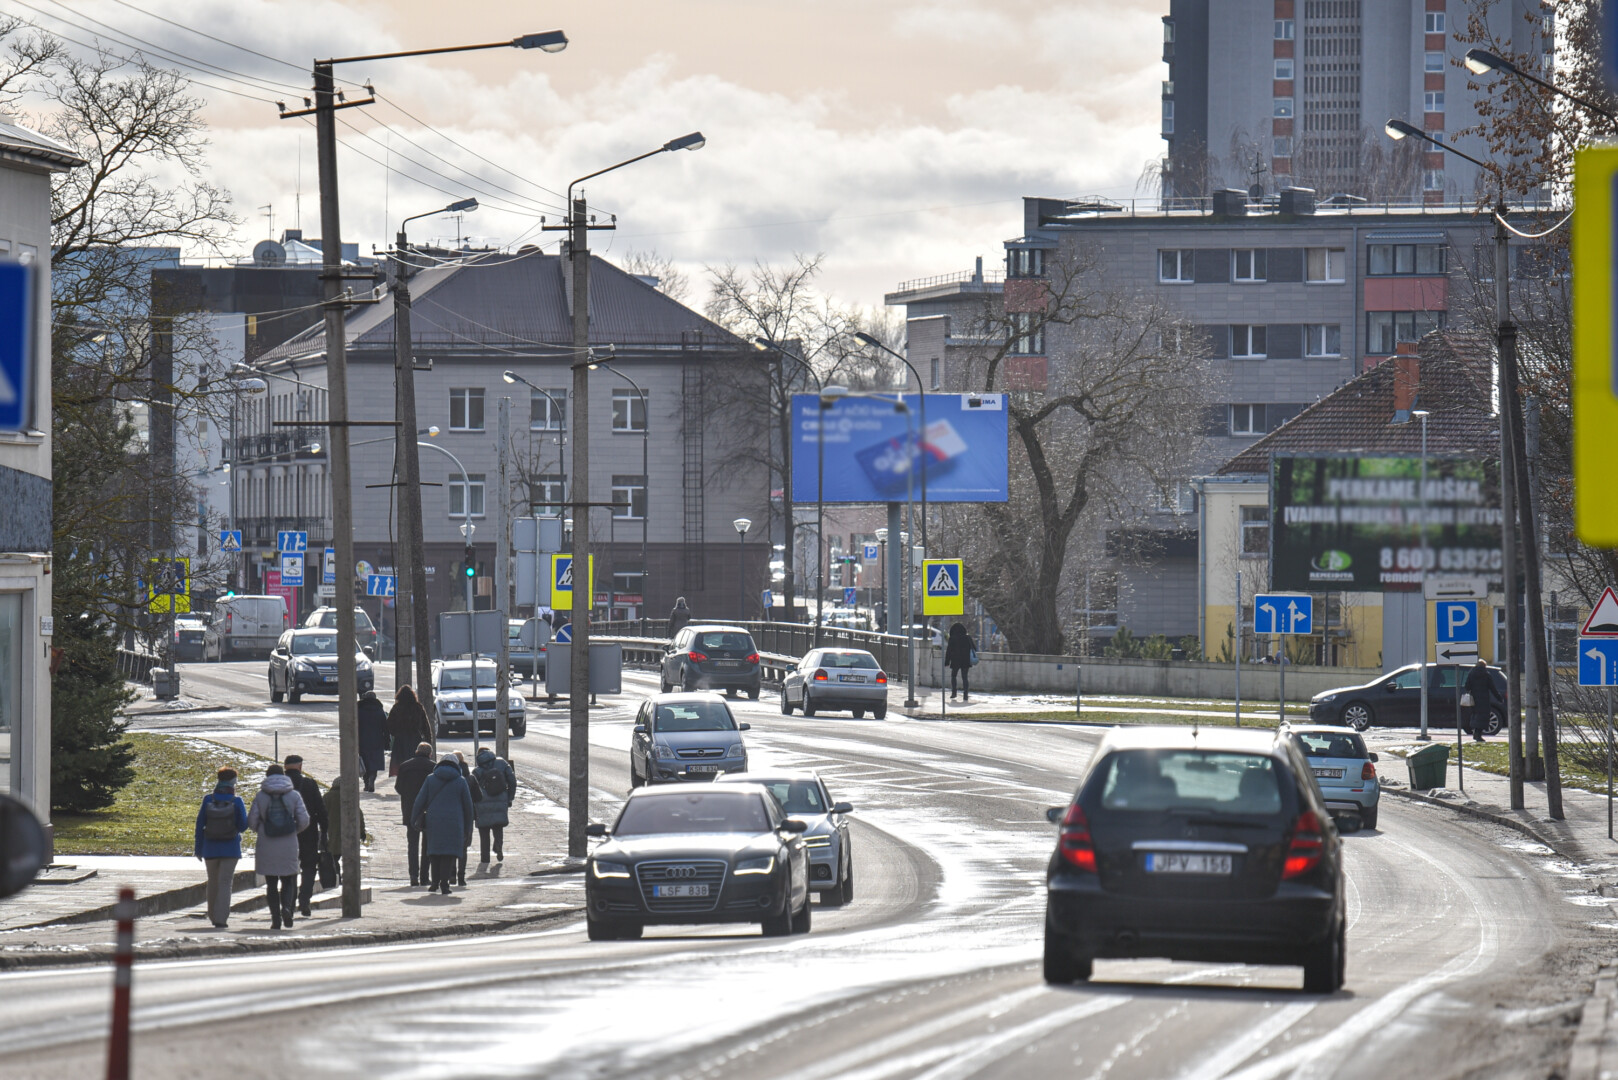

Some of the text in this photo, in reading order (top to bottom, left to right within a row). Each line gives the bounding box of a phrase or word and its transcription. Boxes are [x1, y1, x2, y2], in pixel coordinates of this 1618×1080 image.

[1329, 479, 1416, 500] PERKAME
[1380, 548, 1393, 569] 8
[1397, 548, 1435, 569] 600
[1448, 606, 1471, 638] P
[1156, 854, 1230, 872] JPV 156
[660, 886, 708, 897] LSF 838
